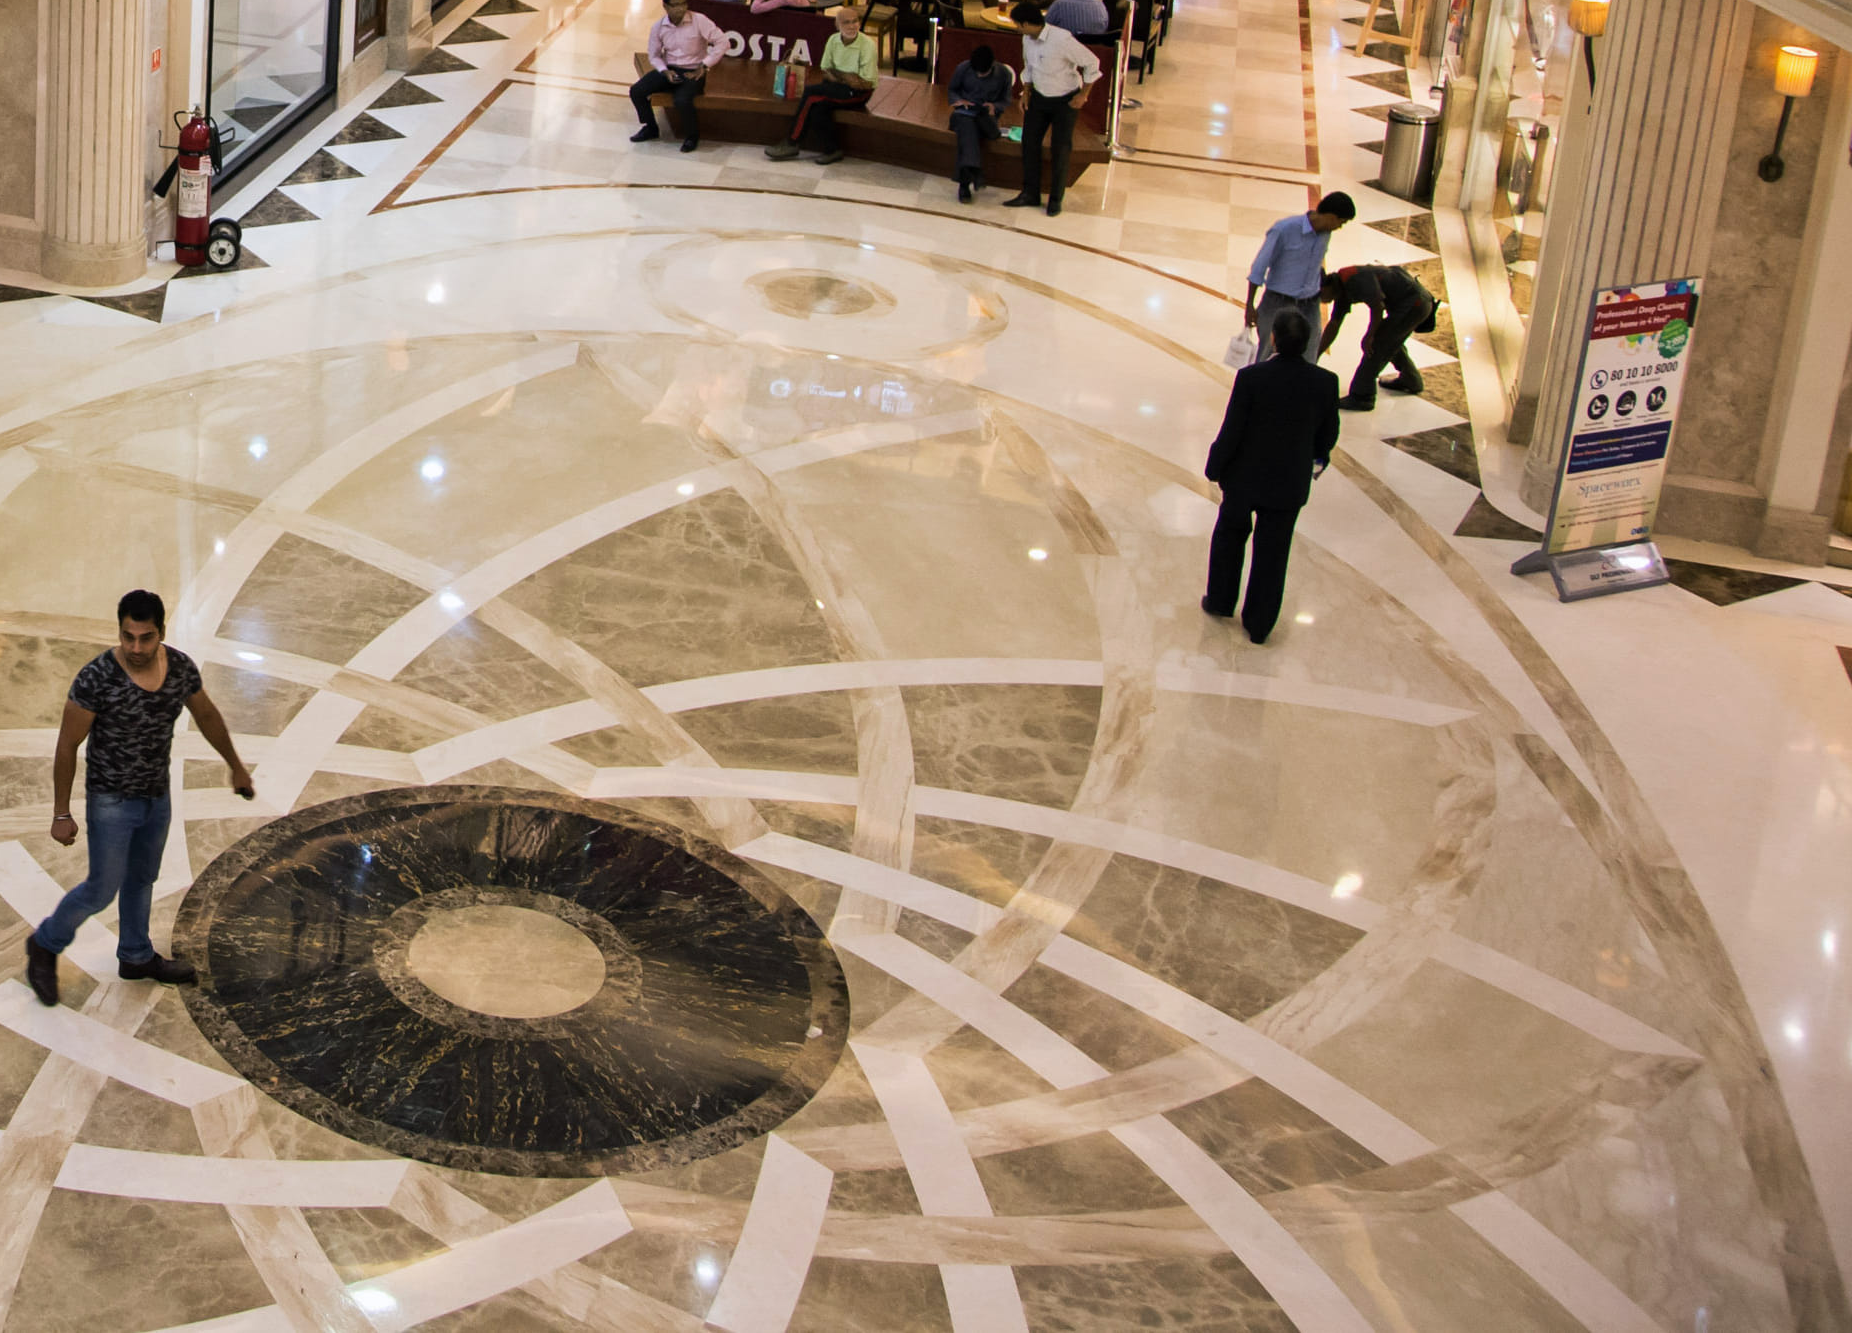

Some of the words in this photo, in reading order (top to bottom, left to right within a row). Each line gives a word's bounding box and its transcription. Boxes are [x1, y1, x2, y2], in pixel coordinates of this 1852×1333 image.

[707, 30, 813, 66] OSTA
[1610, 369, 1623, 382] 80
[1625, 367, 1638, 379] 10
[1640, 365, 1653, 377] 10
